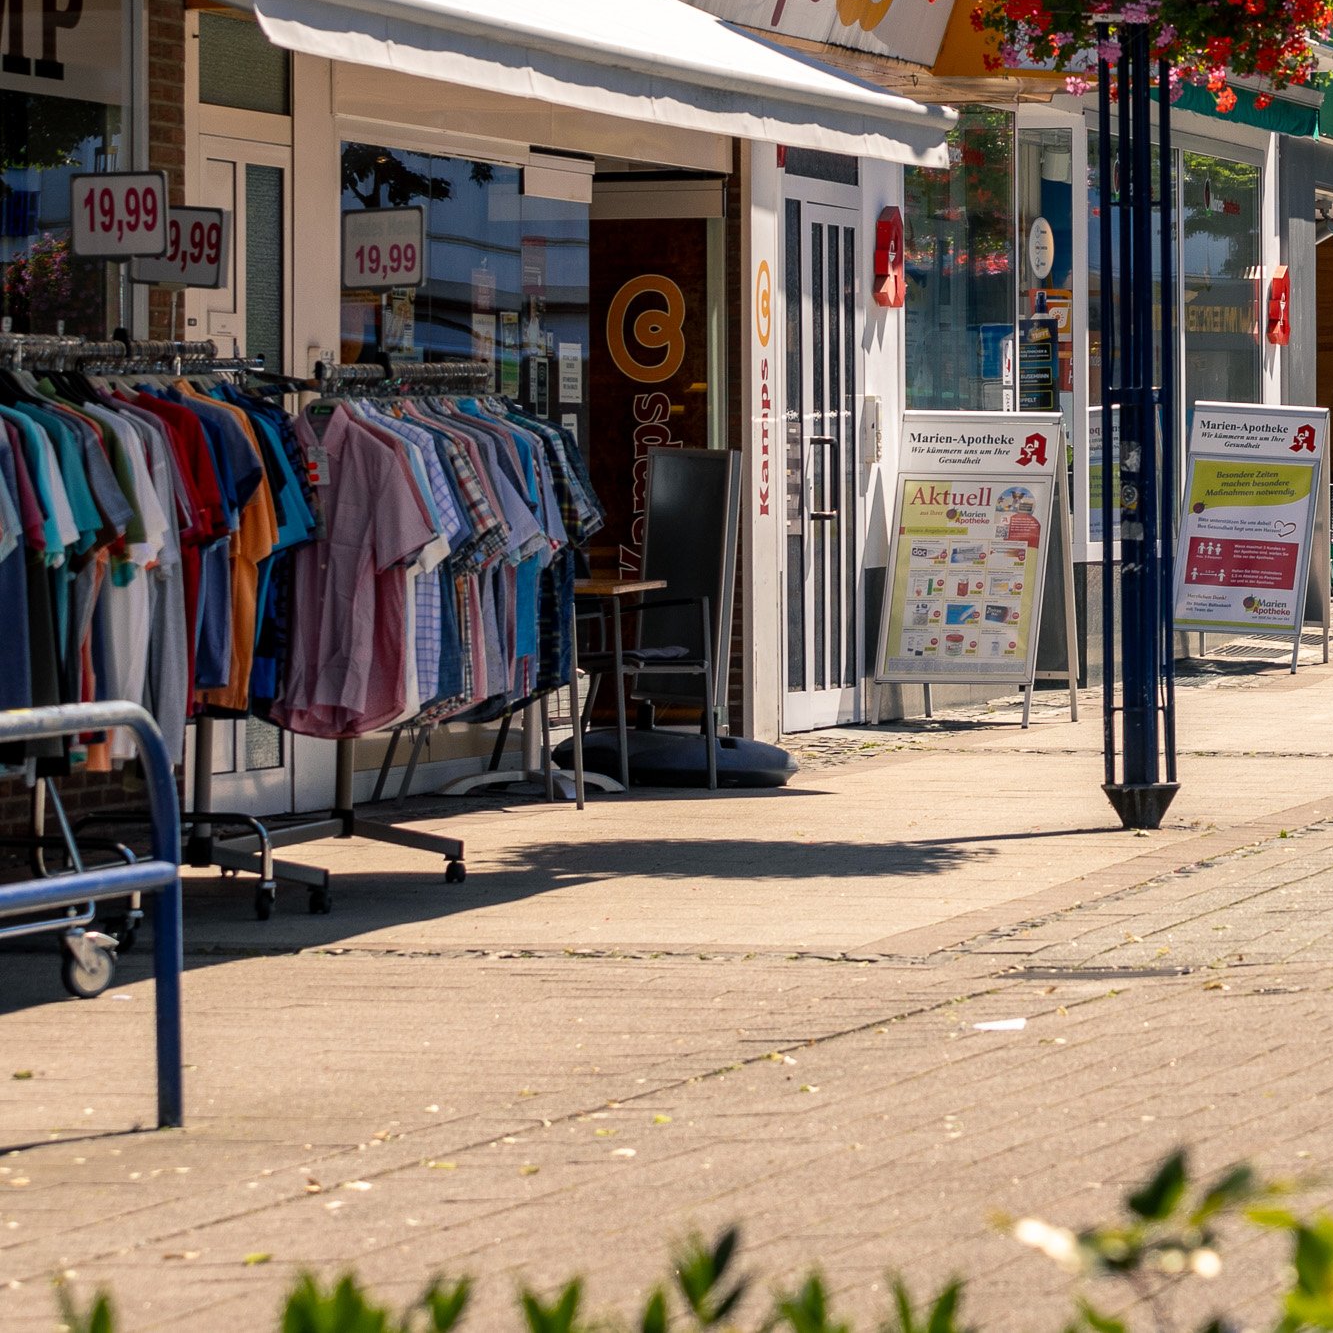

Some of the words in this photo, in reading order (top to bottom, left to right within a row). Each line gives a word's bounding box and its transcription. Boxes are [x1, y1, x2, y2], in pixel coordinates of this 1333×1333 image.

[84, 186, 158, 243] 19,99
[155, 219, 221, 272] 9,99
[355, 242, 417, 280] 19,99
[1200, 420, 1289, 434] Marien-Apotheke
[759, 357, 771, 516] Kamps
[909, 432, 1014, 447] Marien-Apotheke
[1201, 431, 1213, 439] Wir
[1214, 432, 1244, 441] kümmern
[1271, 435, 1286, 443] Ihre
[1224, 441, 1260, 449] Gesundheit
[911, 446, 924, 454] Wir
[926, 446, 962, 455] kümmern
[993, 447, 1010, 455] Ihre
[938, 456, 981, 465] Gesundheit
[1216, 471, 1254, 479] Besondere
[1252, 479, 1290, 487] besondere
[910, 486, 992, 507] Aktuell
[1205, 488, 1254, 497] Maßnahmen
[1256, 488, 1297, 497] notwendig.
[959, 509, 987, 518] Marien
[955, 517, 990, 525] Apotheke
[1258, 598, 1287, 608] Marien
[1252, 606, 1290, 616] Apotheke
